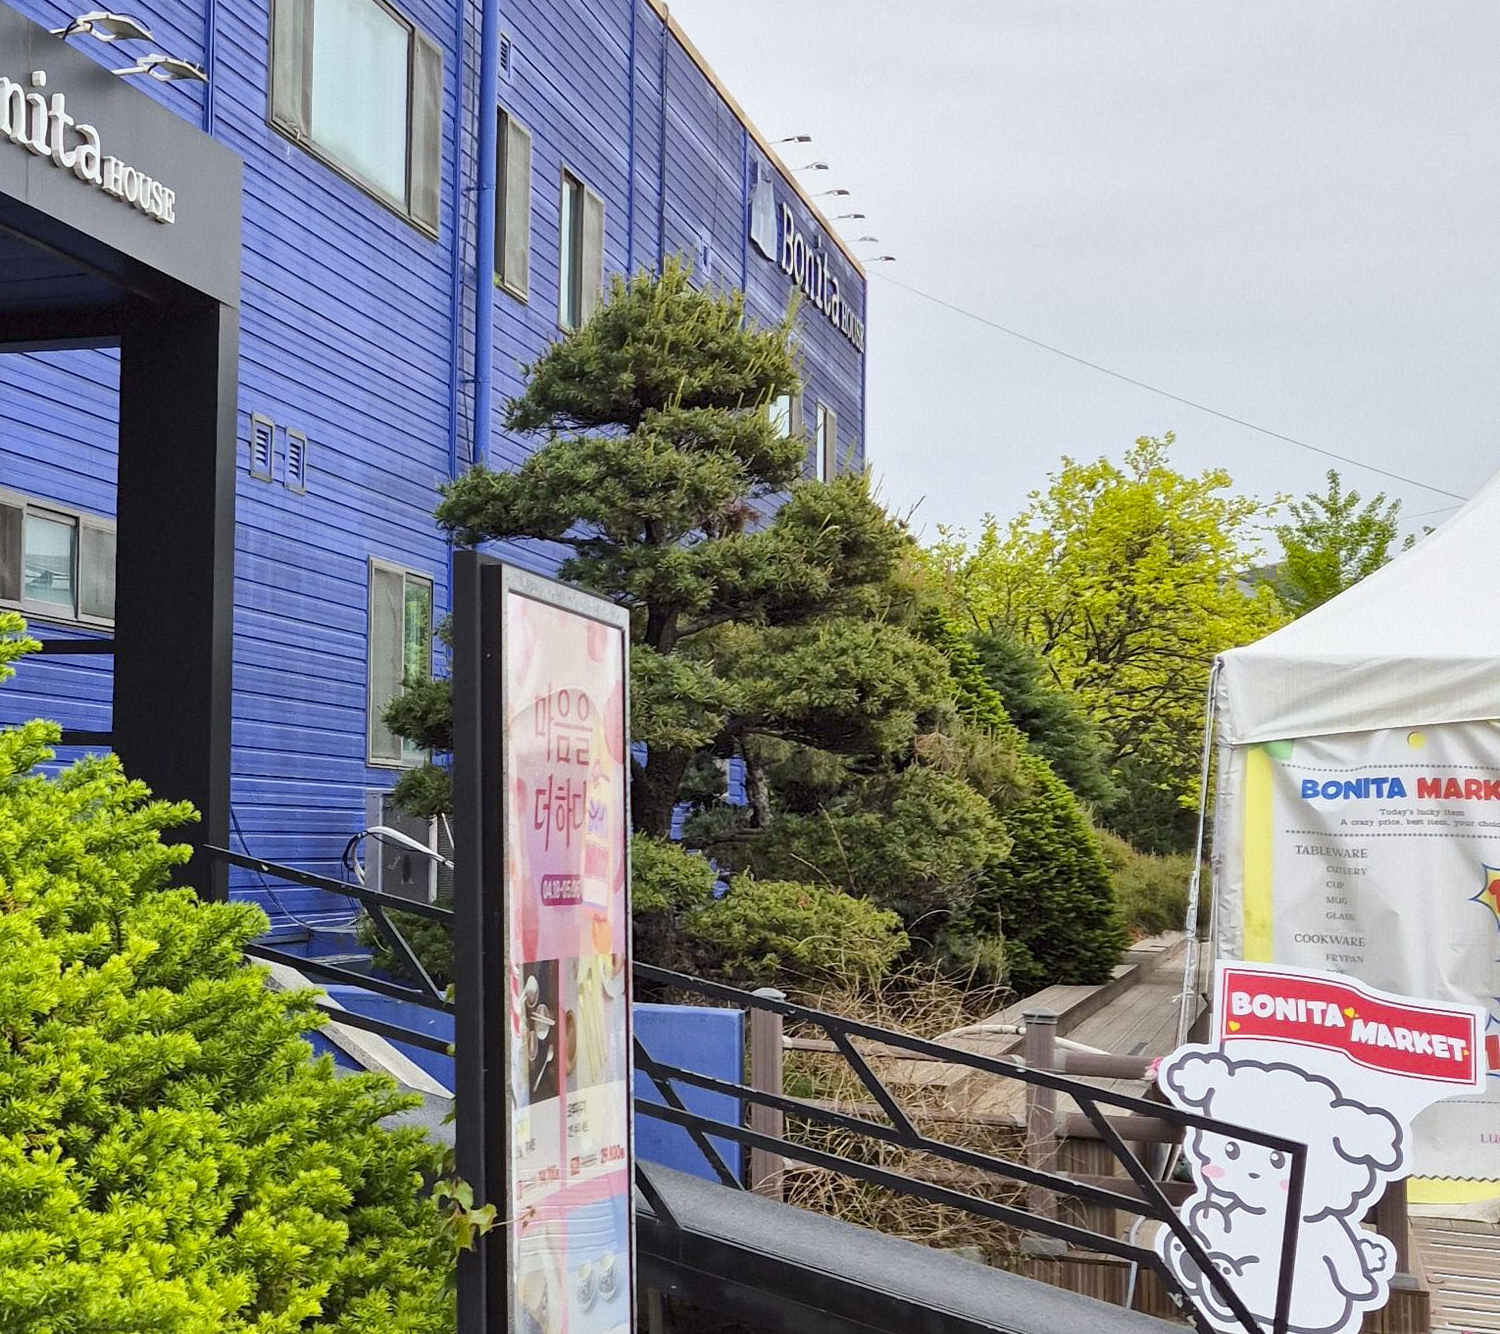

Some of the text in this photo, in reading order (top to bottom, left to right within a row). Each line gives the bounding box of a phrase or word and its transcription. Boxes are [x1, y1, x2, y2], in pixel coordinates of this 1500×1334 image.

[101, 154, 177, 225] HOUSE
[781, 201, 840, 327] Bonita
[534, 682, 594, 766] 마음을
[1301, 776, 1500, 801] BONITA MARK
[1379, 808, 1465, 818] Today's lucky item
[1340, 818, 1348, 826] A
[1351, 819, 1375, 827] crazy
[1453, 820, 1475, 828] your
[1294, 844, 1368, 859] TABLEWARE
[1326, 865, 1368, 876] CUTLERY
[1326, 880, 1344, 889] CUP
[1326, 896, 1348, 905] MUG
[1325, 911, 1356, 922] GLASS
[1294, 933, 1366, 948] COOKWARE
[1325, 953, 1364, 964] FRYPAN
[1231, 991, 1346, 1029] BONITA
[1350, 1018, 1468, 1062] MARKET
[1481, 1132, 1500, 1145] LU
